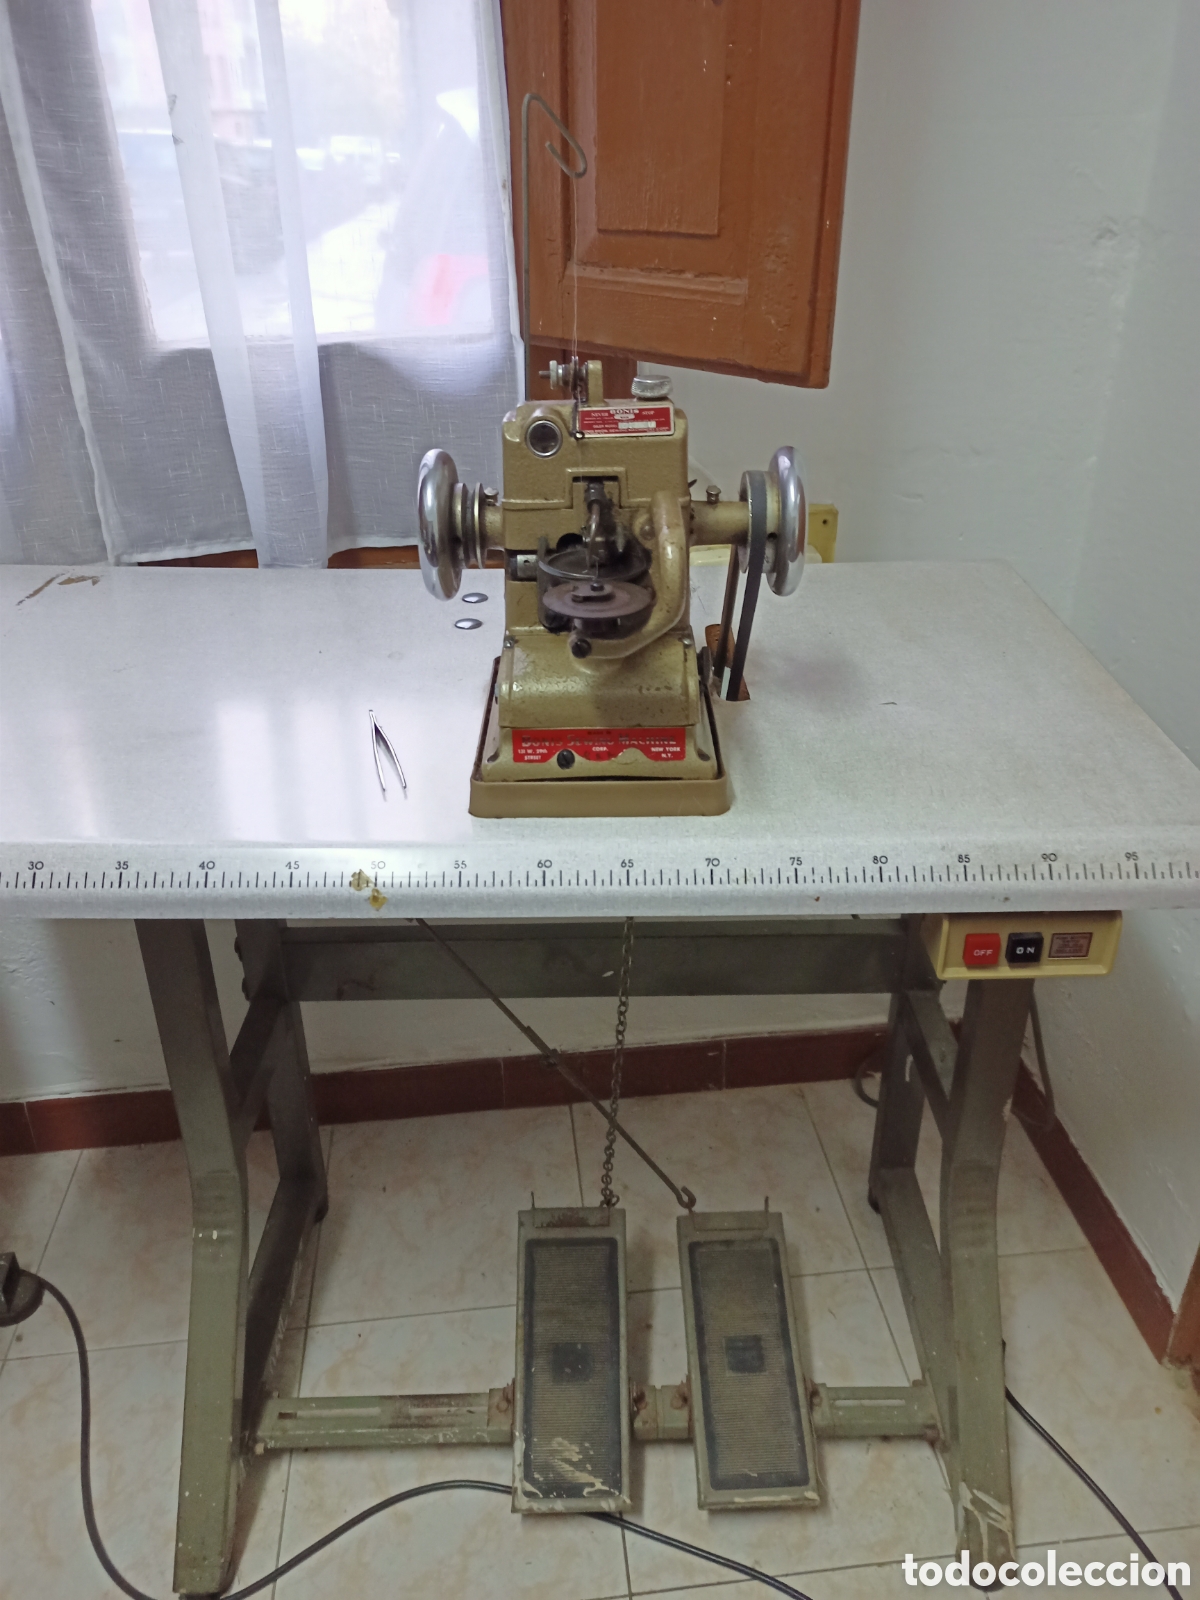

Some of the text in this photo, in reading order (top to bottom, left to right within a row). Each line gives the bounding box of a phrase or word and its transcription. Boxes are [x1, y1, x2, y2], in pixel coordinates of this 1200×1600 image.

[618, 733, 677, 745] MACHINE
[27, 852, 1139, 871] 30 35 40 45 50 55 60 65 70 75 80 85 90 95
[1016, 946, 1035, 954] ON
